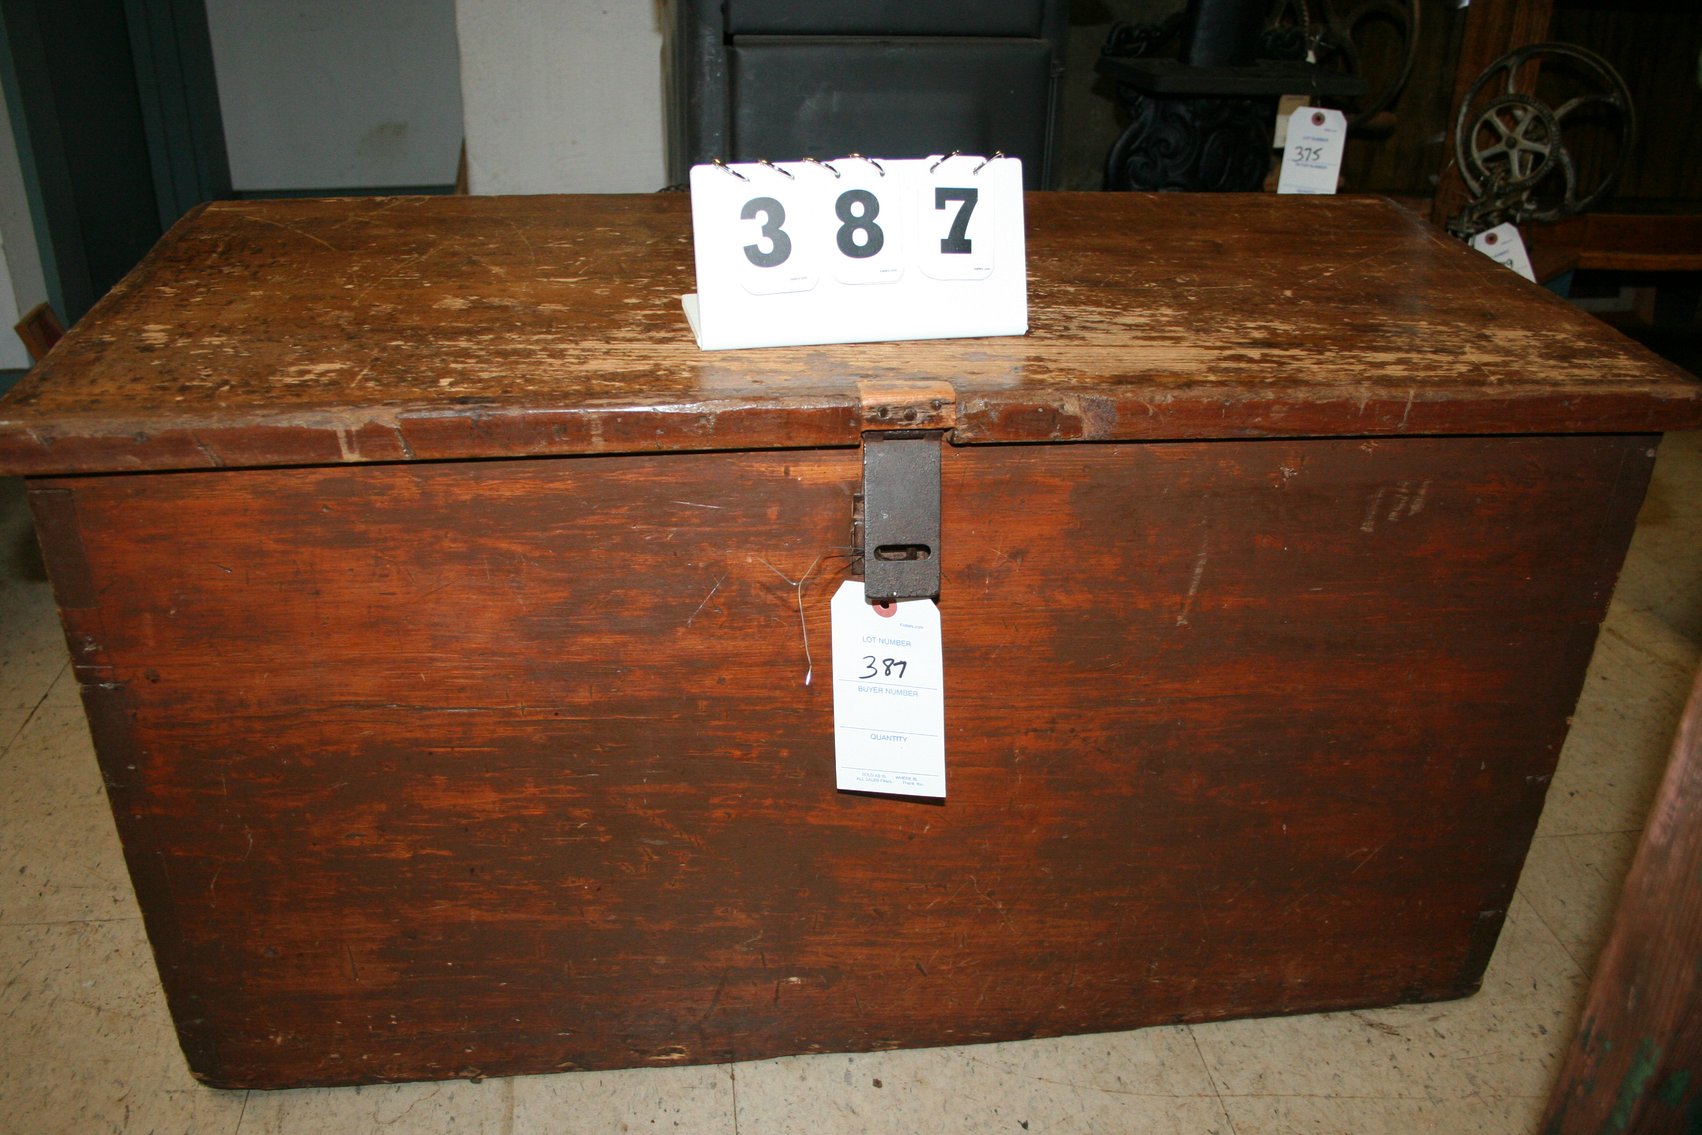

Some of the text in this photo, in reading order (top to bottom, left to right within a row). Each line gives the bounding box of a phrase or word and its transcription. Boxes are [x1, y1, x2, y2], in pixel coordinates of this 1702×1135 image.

[1292, 145, 1323, 162] 375
[862, 635, 912, 647] LOT NUMBER
[858, 655, 907, 679] 387
[857, 685, 919, 697] BUYER NUMBER
[870, 733, 908, 743] QUANTITY
